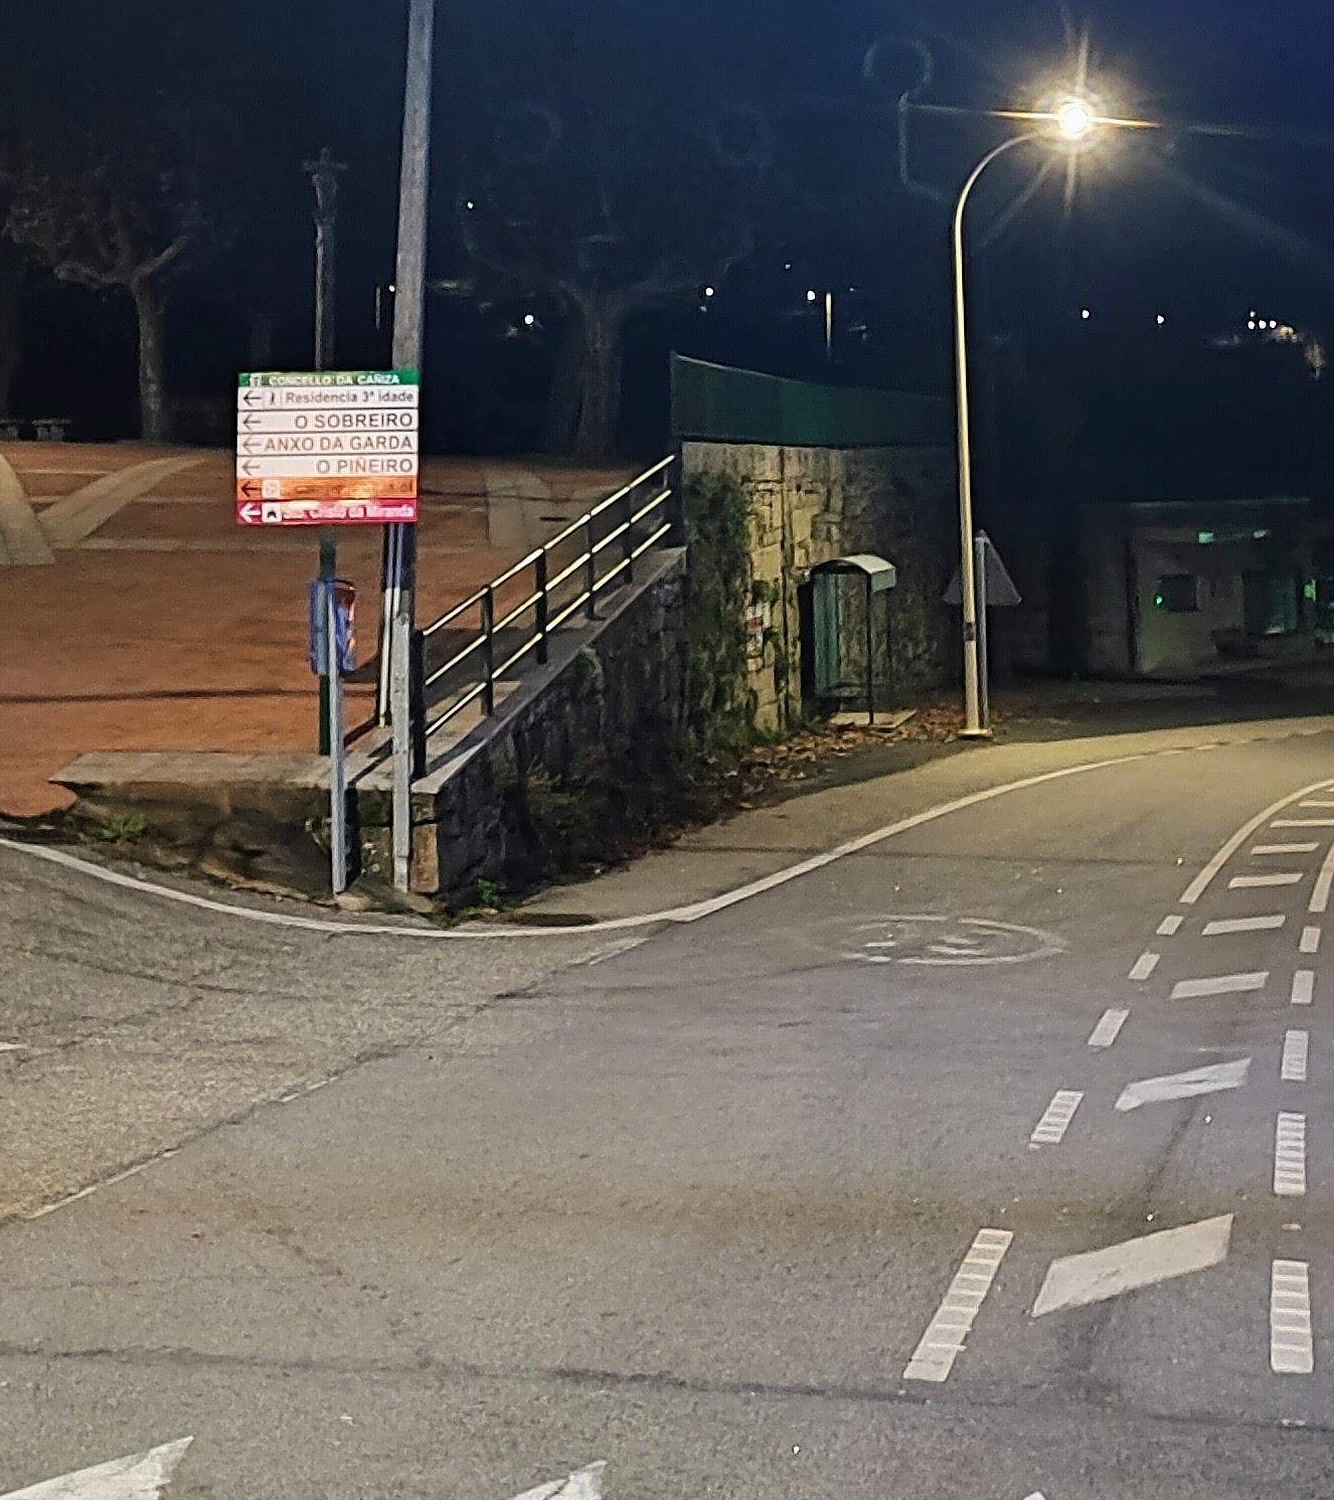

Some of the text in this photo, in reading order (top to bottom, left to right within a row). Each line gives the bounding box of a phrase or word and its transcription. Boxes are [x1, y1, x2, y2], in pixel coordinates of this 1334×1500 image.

[269, 375, 332, 386] CONCELLO
[336, 375, 353, 385] DA
[285, 391, 358, 404] Residencia
[294, 413, 413, 429] O SOBREIRO
[264, 435, 413, 452] ANXO DA GARDA
[317, 456, 413, 474] O PIÑEIRO
